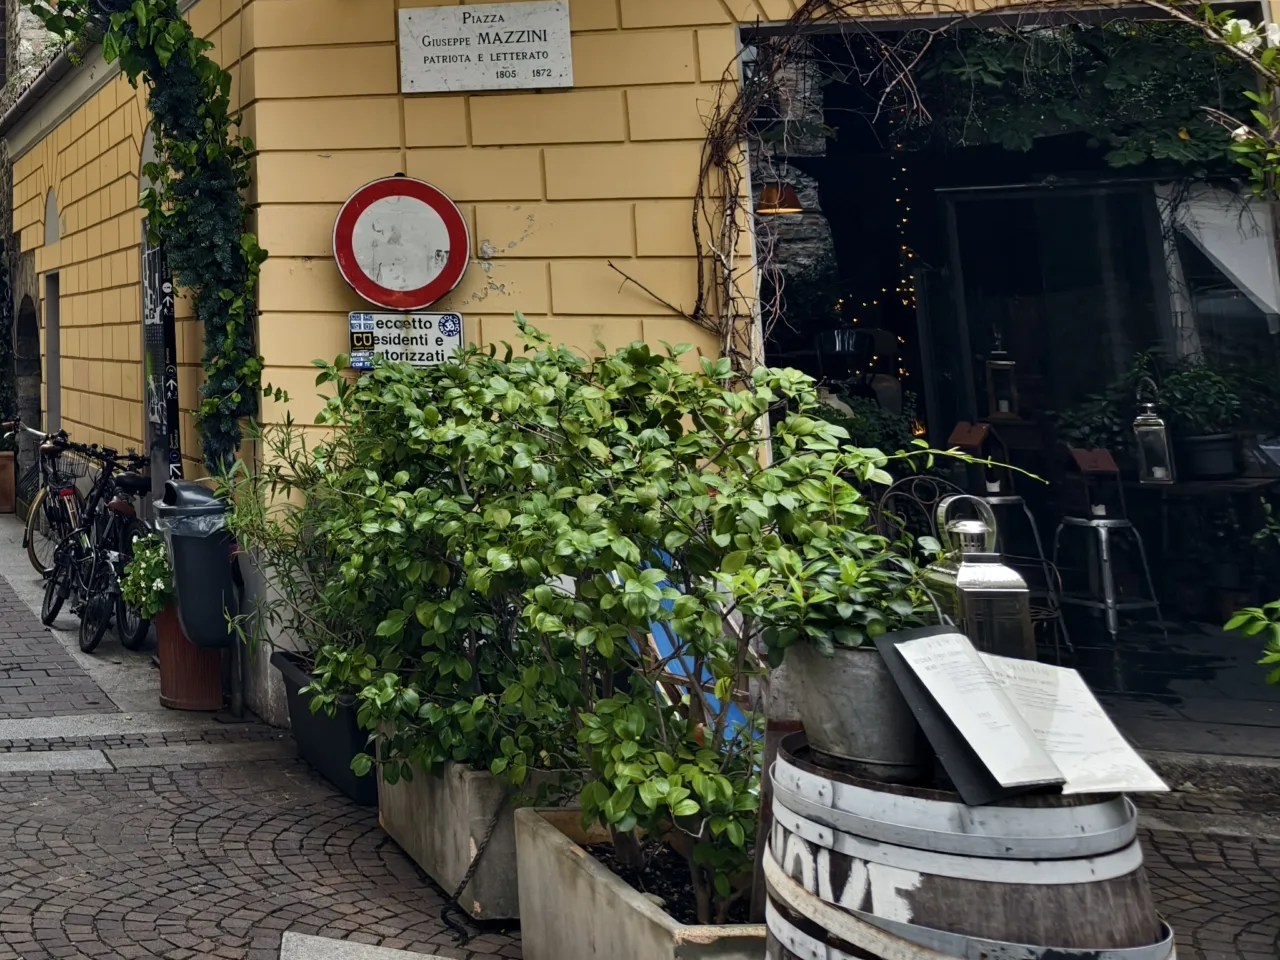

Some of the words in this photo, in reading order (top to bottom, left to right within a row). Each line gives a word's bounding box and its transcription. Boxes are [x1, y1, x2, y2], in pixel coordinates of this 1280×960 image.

[477, 29, 548, 45] MAZZINI
[423, 53, 471, 64] PATRIOTA
[478, 53, 484, 62] E
[490, 51, 549, 61] LETTERATO
[495, 70, 517, 79] 1805
[532, 68, 552, 77] 1872
[376, 318, 432, 330] eccetto
[372, 333, 428, 346] esidenti
[435, 336, 444, 346] e
